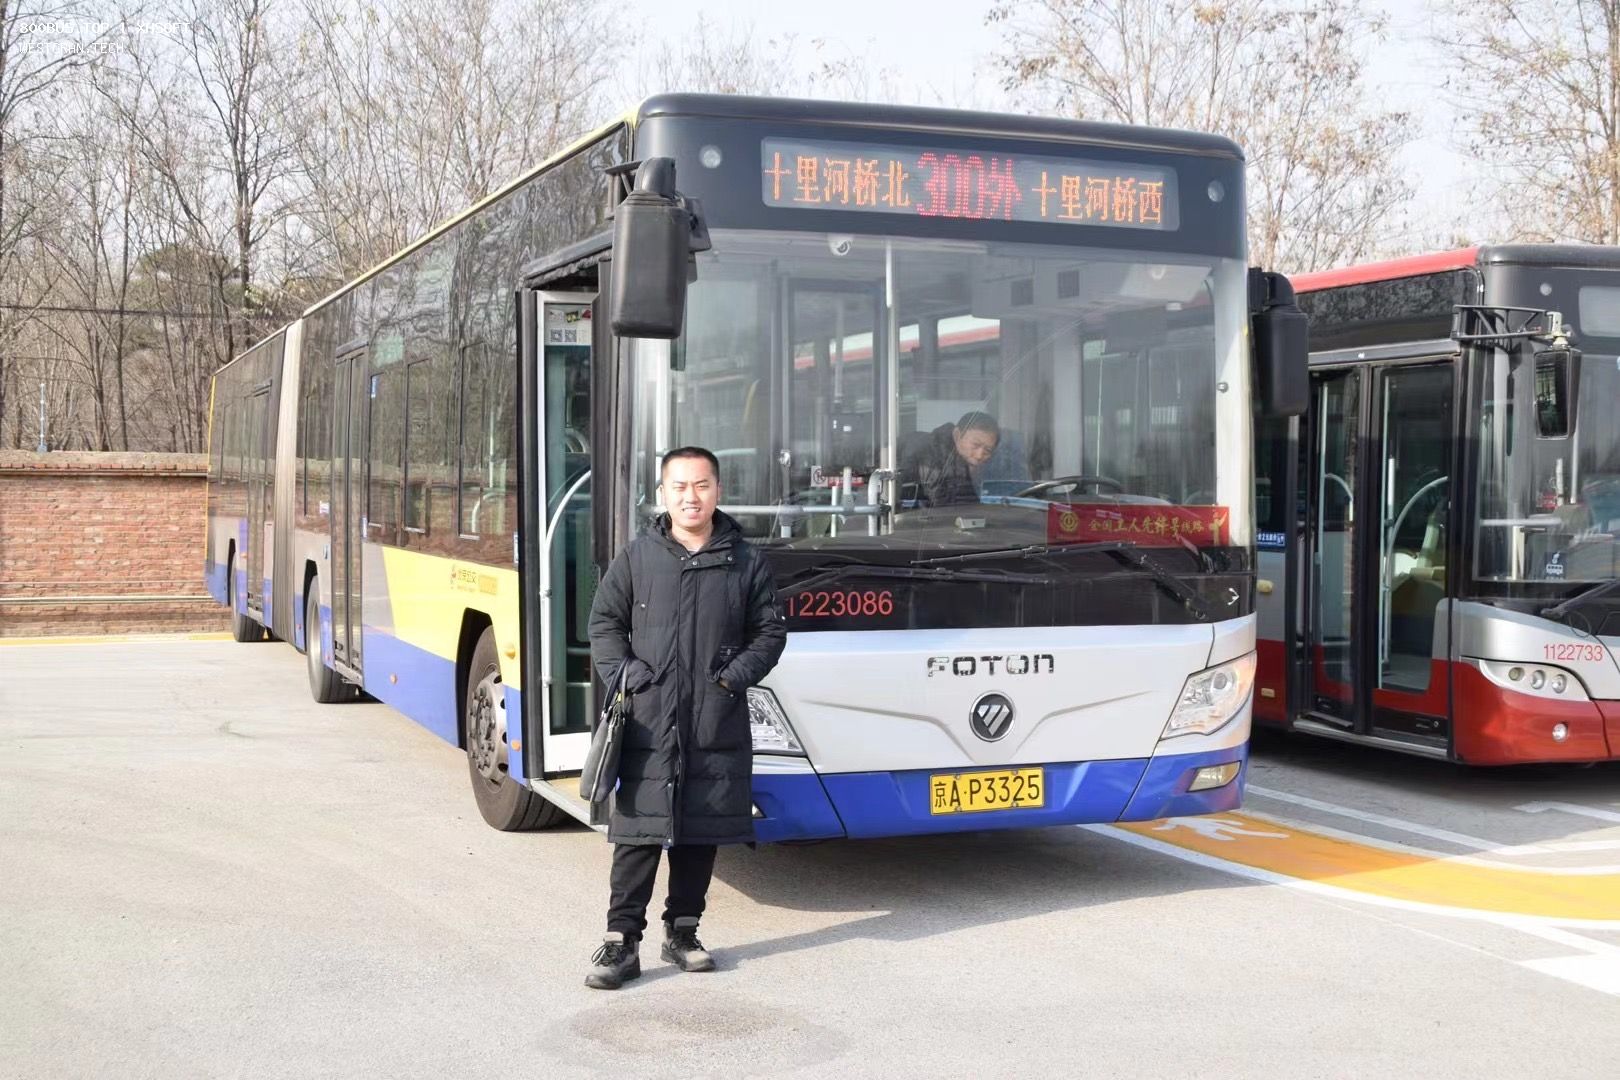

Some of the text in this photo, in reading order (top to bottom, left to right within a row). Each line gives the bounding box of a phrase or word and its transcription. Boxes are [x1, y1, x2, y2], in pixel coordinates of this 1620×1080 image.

[764, 151, 911, 207] 十里河桥北
[1031, 171, 1164, 224] 十里河桥西
[786, 591, 893, 616] 1223086
[1543, 644, 1603, 661] 1122733
[927, 653, 1054, 677] FOTON
